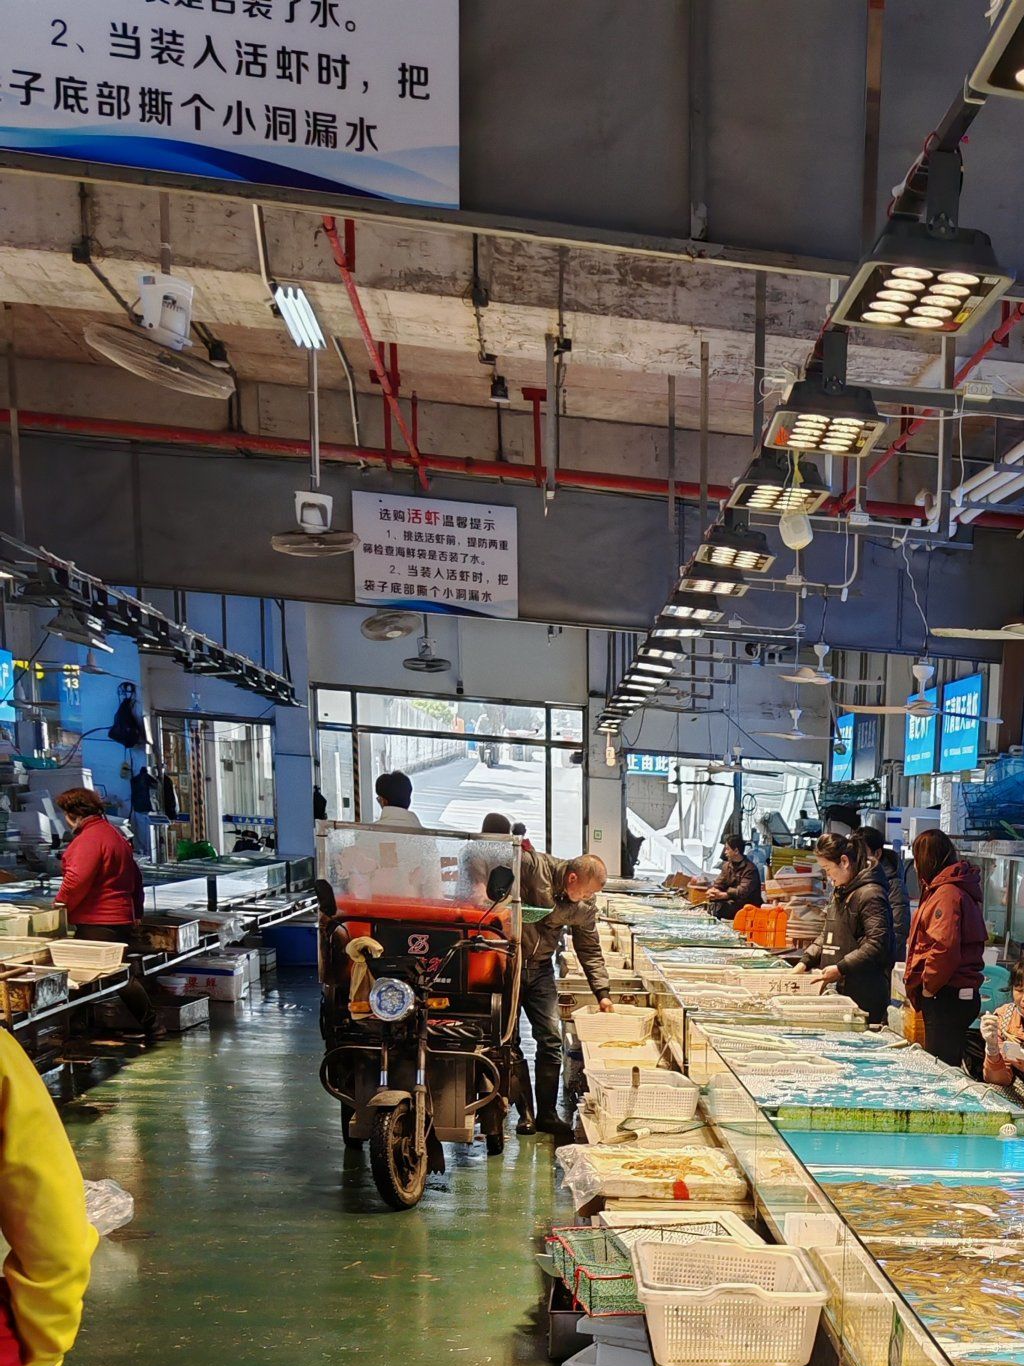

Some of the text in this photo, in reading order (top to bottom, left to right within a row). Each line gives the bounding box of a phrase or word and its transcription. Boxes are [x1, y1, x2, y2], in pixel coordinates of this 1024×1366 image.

[0, 68, 379, 152] 子底部撕个小洞漏水
[379, 507, 496, 532] 选购活虾温馨提示
[363, 579, 493, 603] 袋子底部撕个小洞漏水
